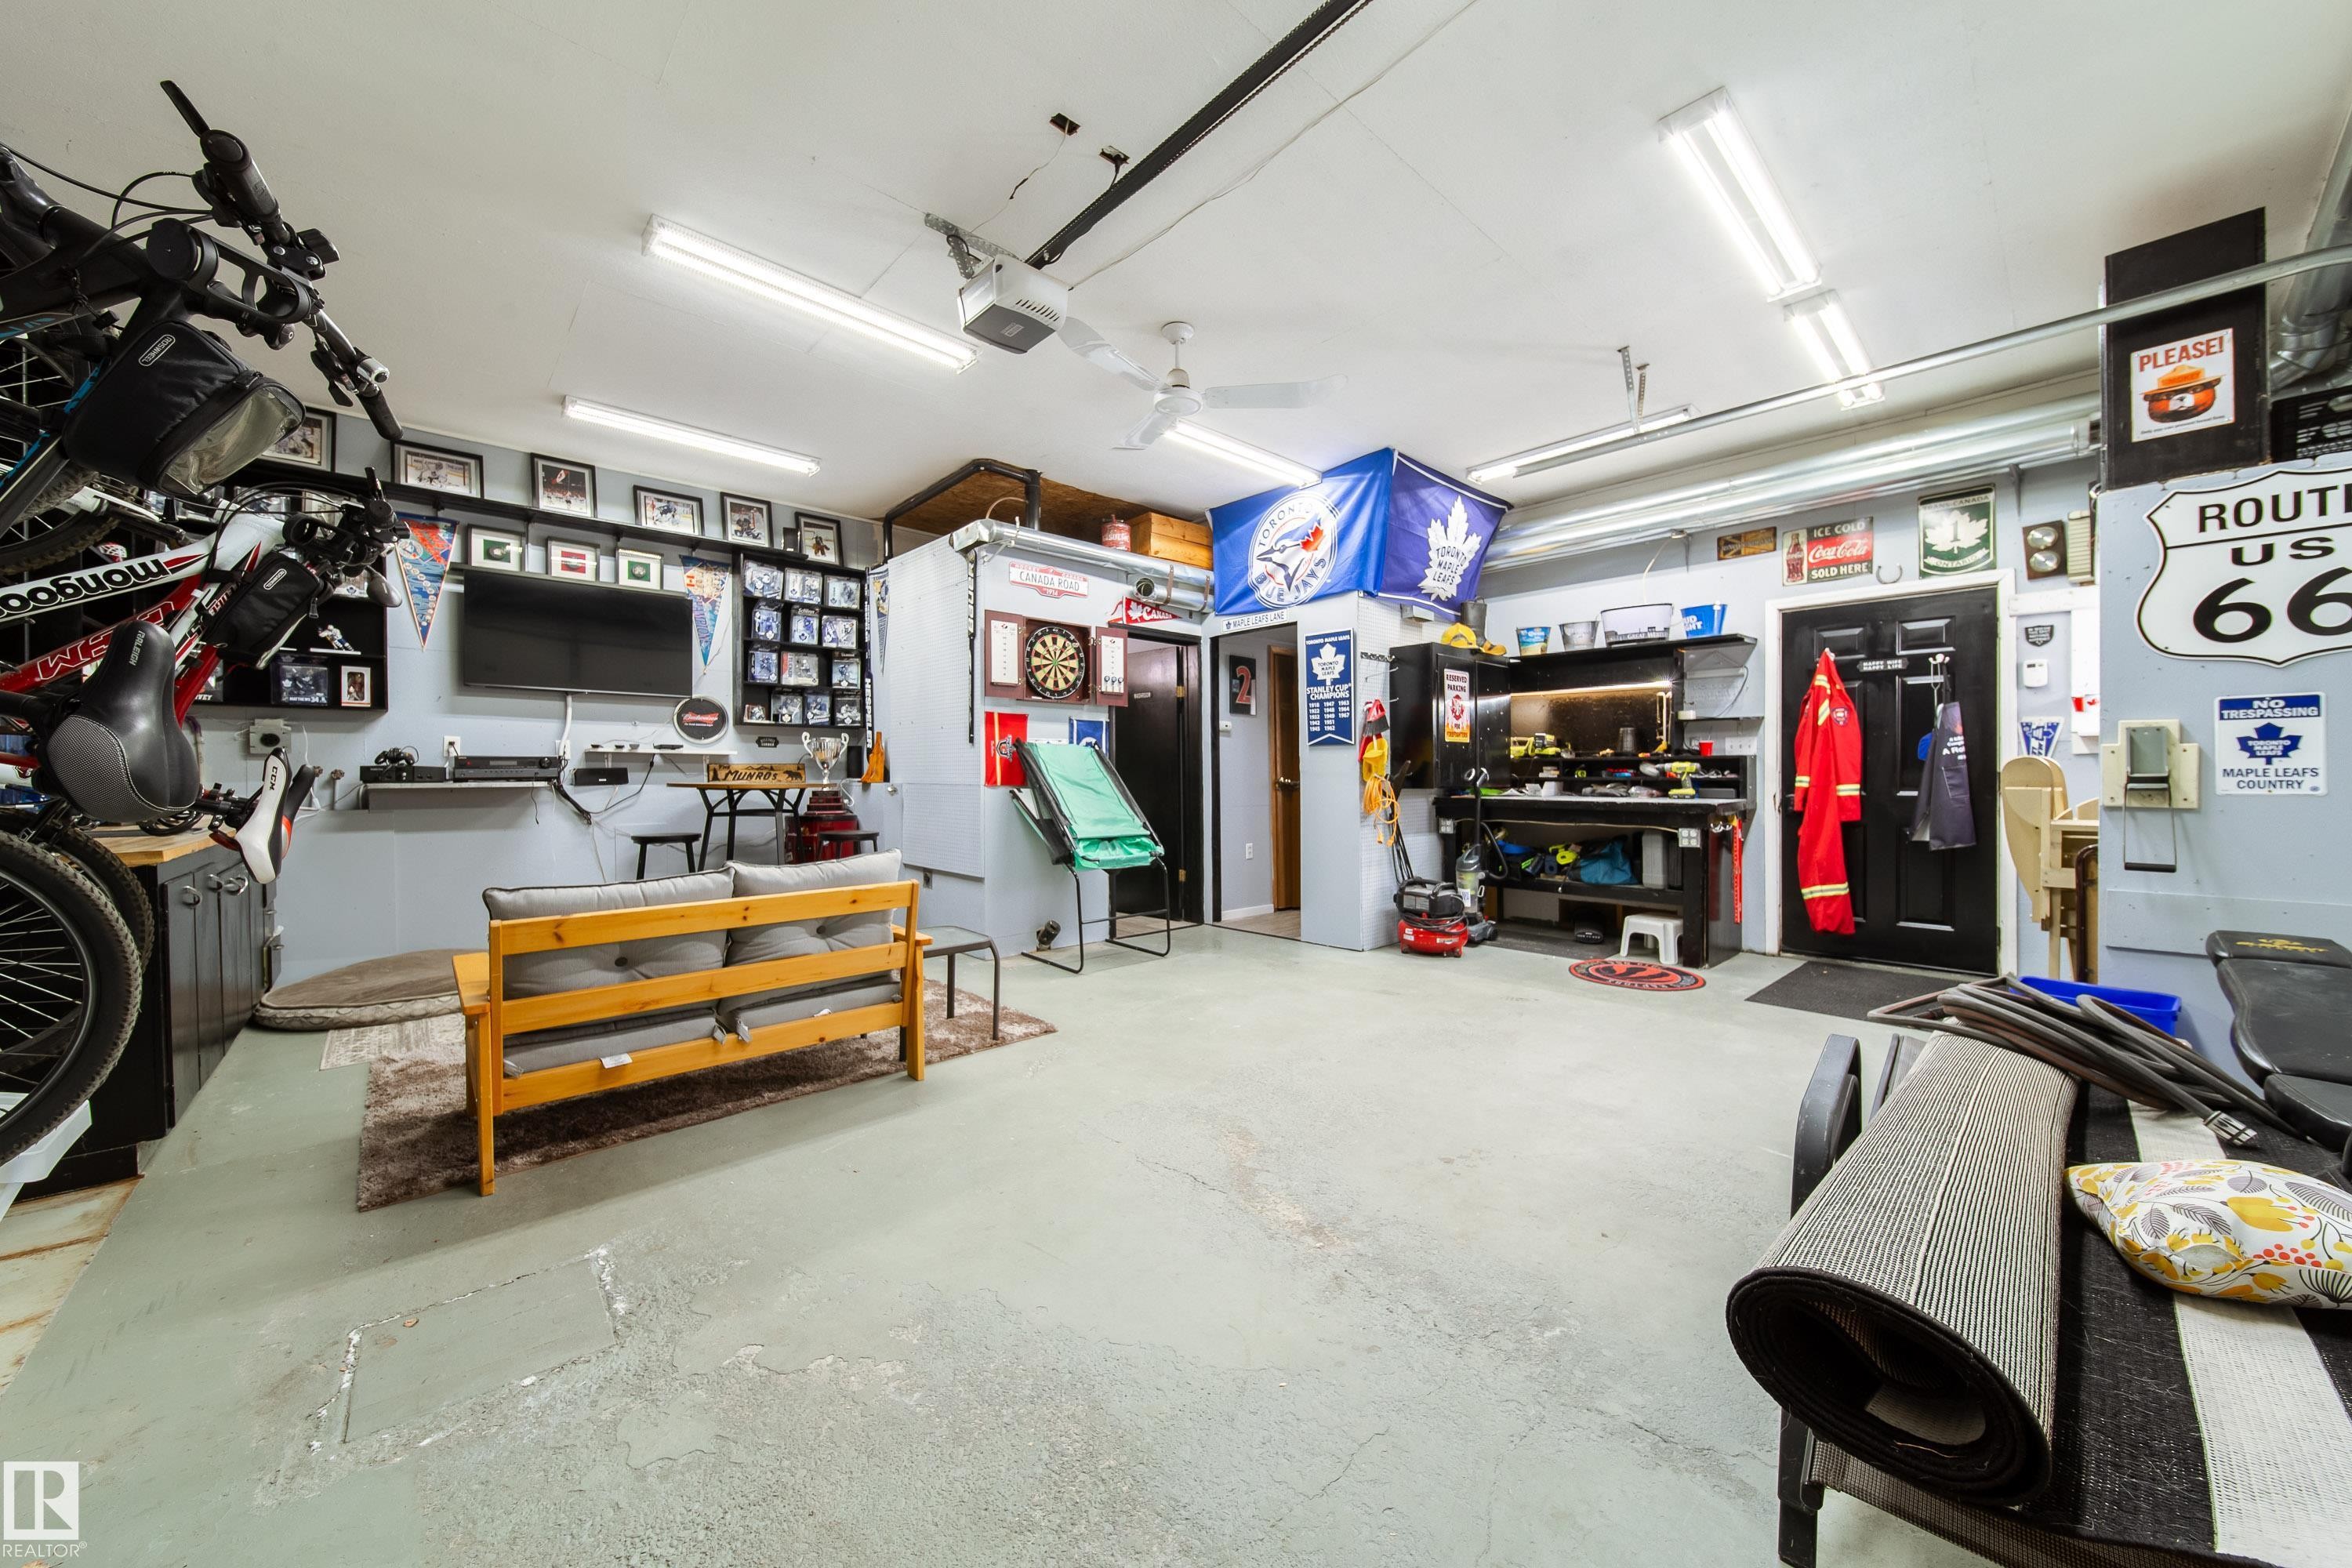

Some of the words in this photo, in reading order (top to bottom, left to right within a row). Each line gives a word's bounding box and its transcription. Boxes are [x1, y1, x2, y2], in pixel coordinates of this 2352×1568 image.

[2139, 336, 2223, 372] PLEASE!
[1813, 526, 1831, 538] ICE
[1835, 521, 1866, 534] COLD
[1950, 521, 1961, 543] 1
[1436, 546, 1467, 567] TORONTO
[1935, 555, 1979, 567] ONTARIO
[1437, 559, 1460, 574] MAPLE
[1811, 568, 1838, 579] SOLD
[1839, 561, 1868, 574] HERE
[1019, 571, 1055, 587] CANADA
[1058, 578, 1080, 592] ROAD
[1294, 557, 1327, 601] JAYS
[1433, 571, 1455, 585] LEAFS
[0, 558, 172, 619] mongoo
[1142, 606, 1173, 621] CANADA
[2193, 566, 2352, 644] 66
[1232, 617, 1251, 628] MAPLE
[1252, 614, 1269, 624] LEAFS
[1270, 611, 1285, 622] LANE
[129, 630, 145, 666] RALEIGH
[1236, 666, 1251, 704] 2
[1446, 673, 1468, 684] RESERVED
[1306, 685, 1334, 695] STANLEY
[1310, 691, 1350, 700] CHAMPIONS
[1447, 684, 1466, 692] PARKING
[2221, 706, 2318, 719] TRESPASSING
[2252, 699, 2285, 709] NO
[269, 766, 278, 791] CCM
[2223, 768, 2270, 778] MAPLE
[2274, 768, 2320, 777] LEAFS
[2237, 779, 2304, 789] COUNTRY
